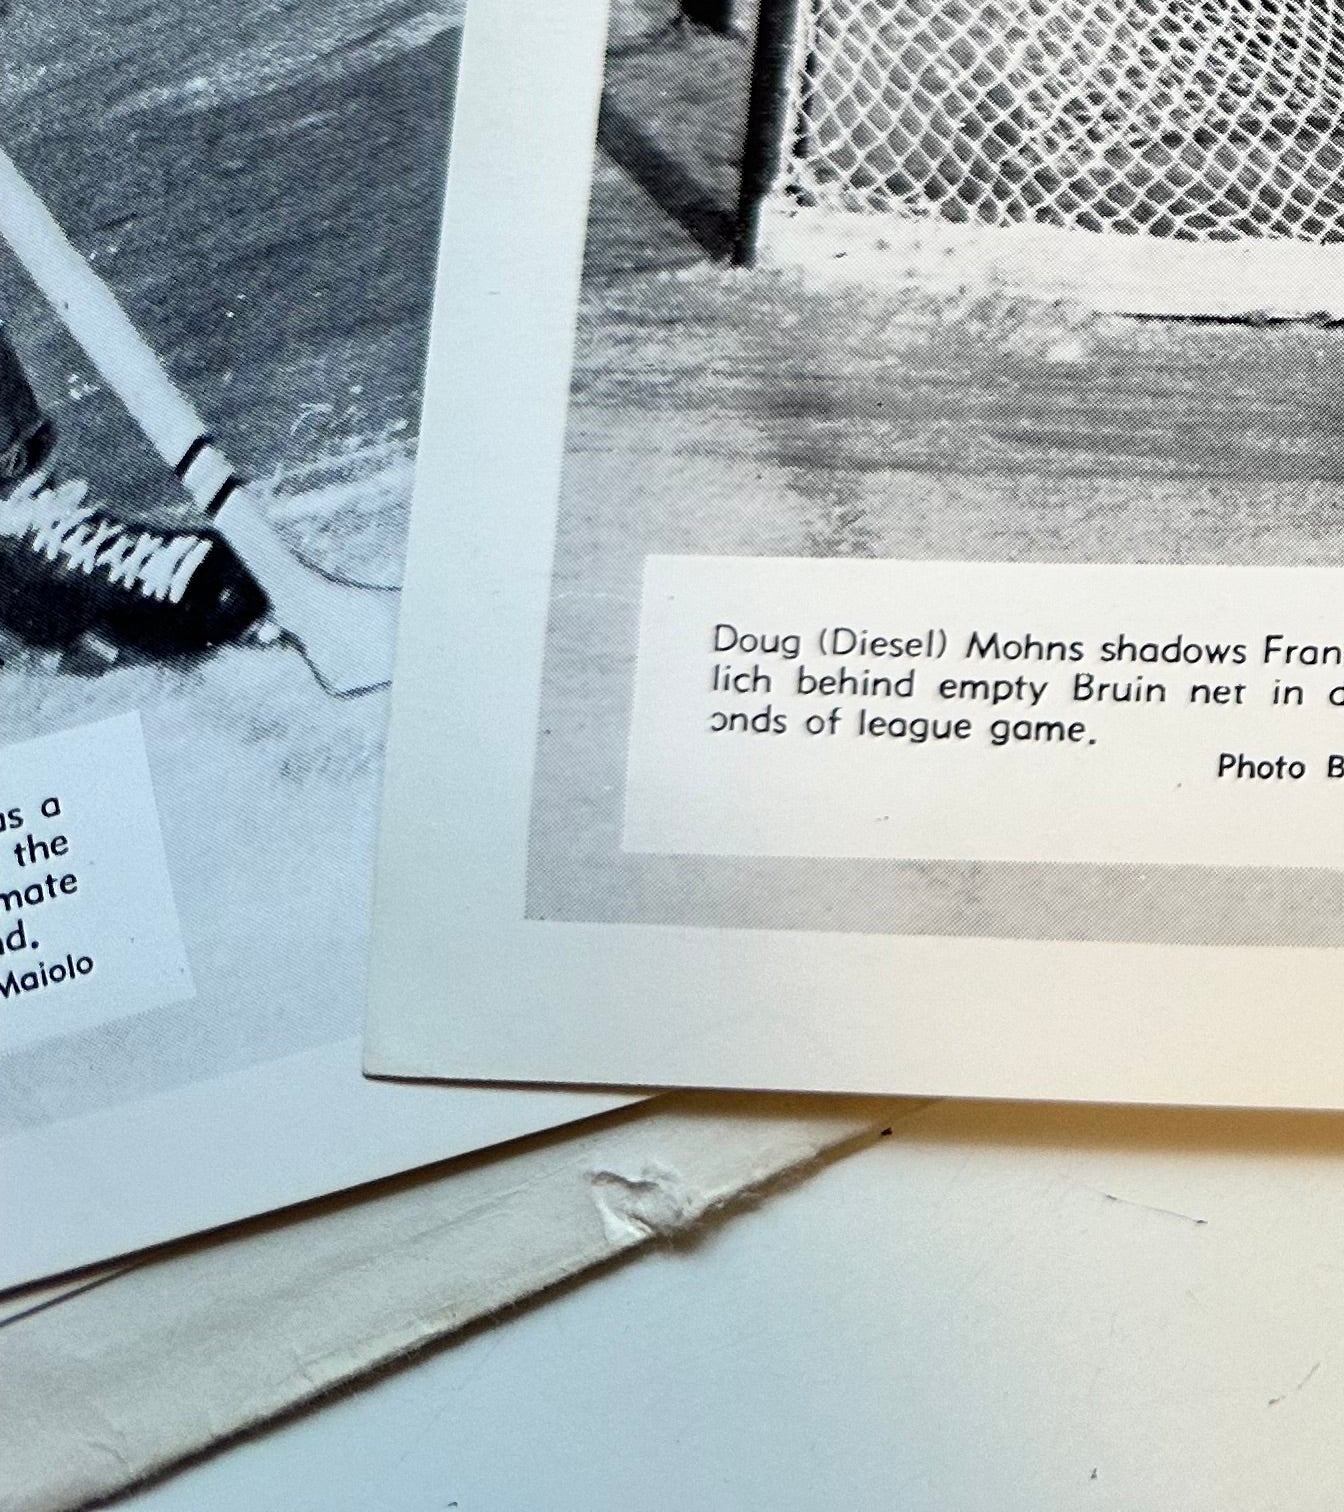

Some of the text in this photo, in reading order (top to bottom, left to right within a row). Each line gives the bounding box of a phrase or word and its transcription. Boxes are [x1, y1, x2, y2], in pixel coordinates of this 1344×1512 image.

[714, 623, 800, 660] Doug
[819, 628, 948, 659] (Diesel)
[965, 631, 1084, 662] Mohns
[1100, 633, 1247, 665] shadows
[713, 664, 772, 694] lich
[797, 664, 915, 698] behind
[938, 672, 1049, 707] empty
[1073, 672, 1166, 703] Bruin
[1190, 683, 1247, 705] net
[1272, 679, 1304, 706] in
[805, 706, 841, 735] of
[858, 708, 972, 744] league
[989, 719, 1096, 747] game.
[1217, 752, 1306, 780] Photo
[41, 797, 61, 818] a
[14, 833, 69, 867] the
